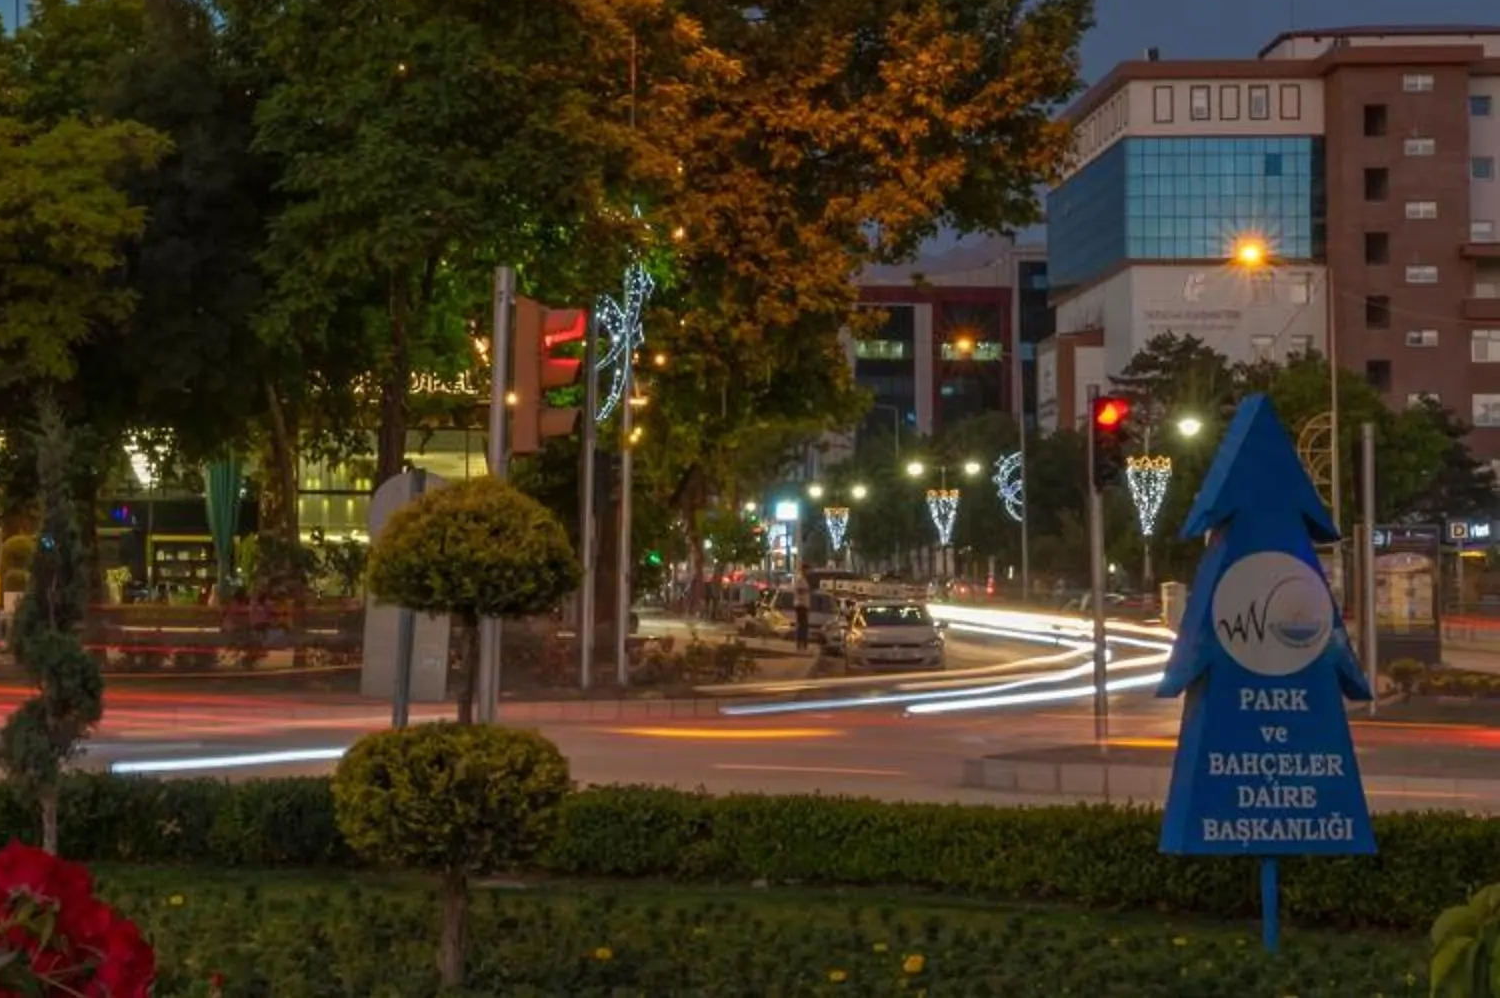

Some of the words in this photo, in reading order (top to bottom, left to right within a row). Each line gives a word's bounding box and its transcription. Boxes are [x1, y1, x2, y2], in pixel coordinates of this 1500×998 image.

[1239, 688, 1308, 711] PARK
[1260, 726, 1288, 743] ve
[1208, 753, 1344, 782] BAHÇELER
[1237, 780, 1318, 809] DAİRE
[1202, 812, 1355, 848] BAŞKANLIĞI
